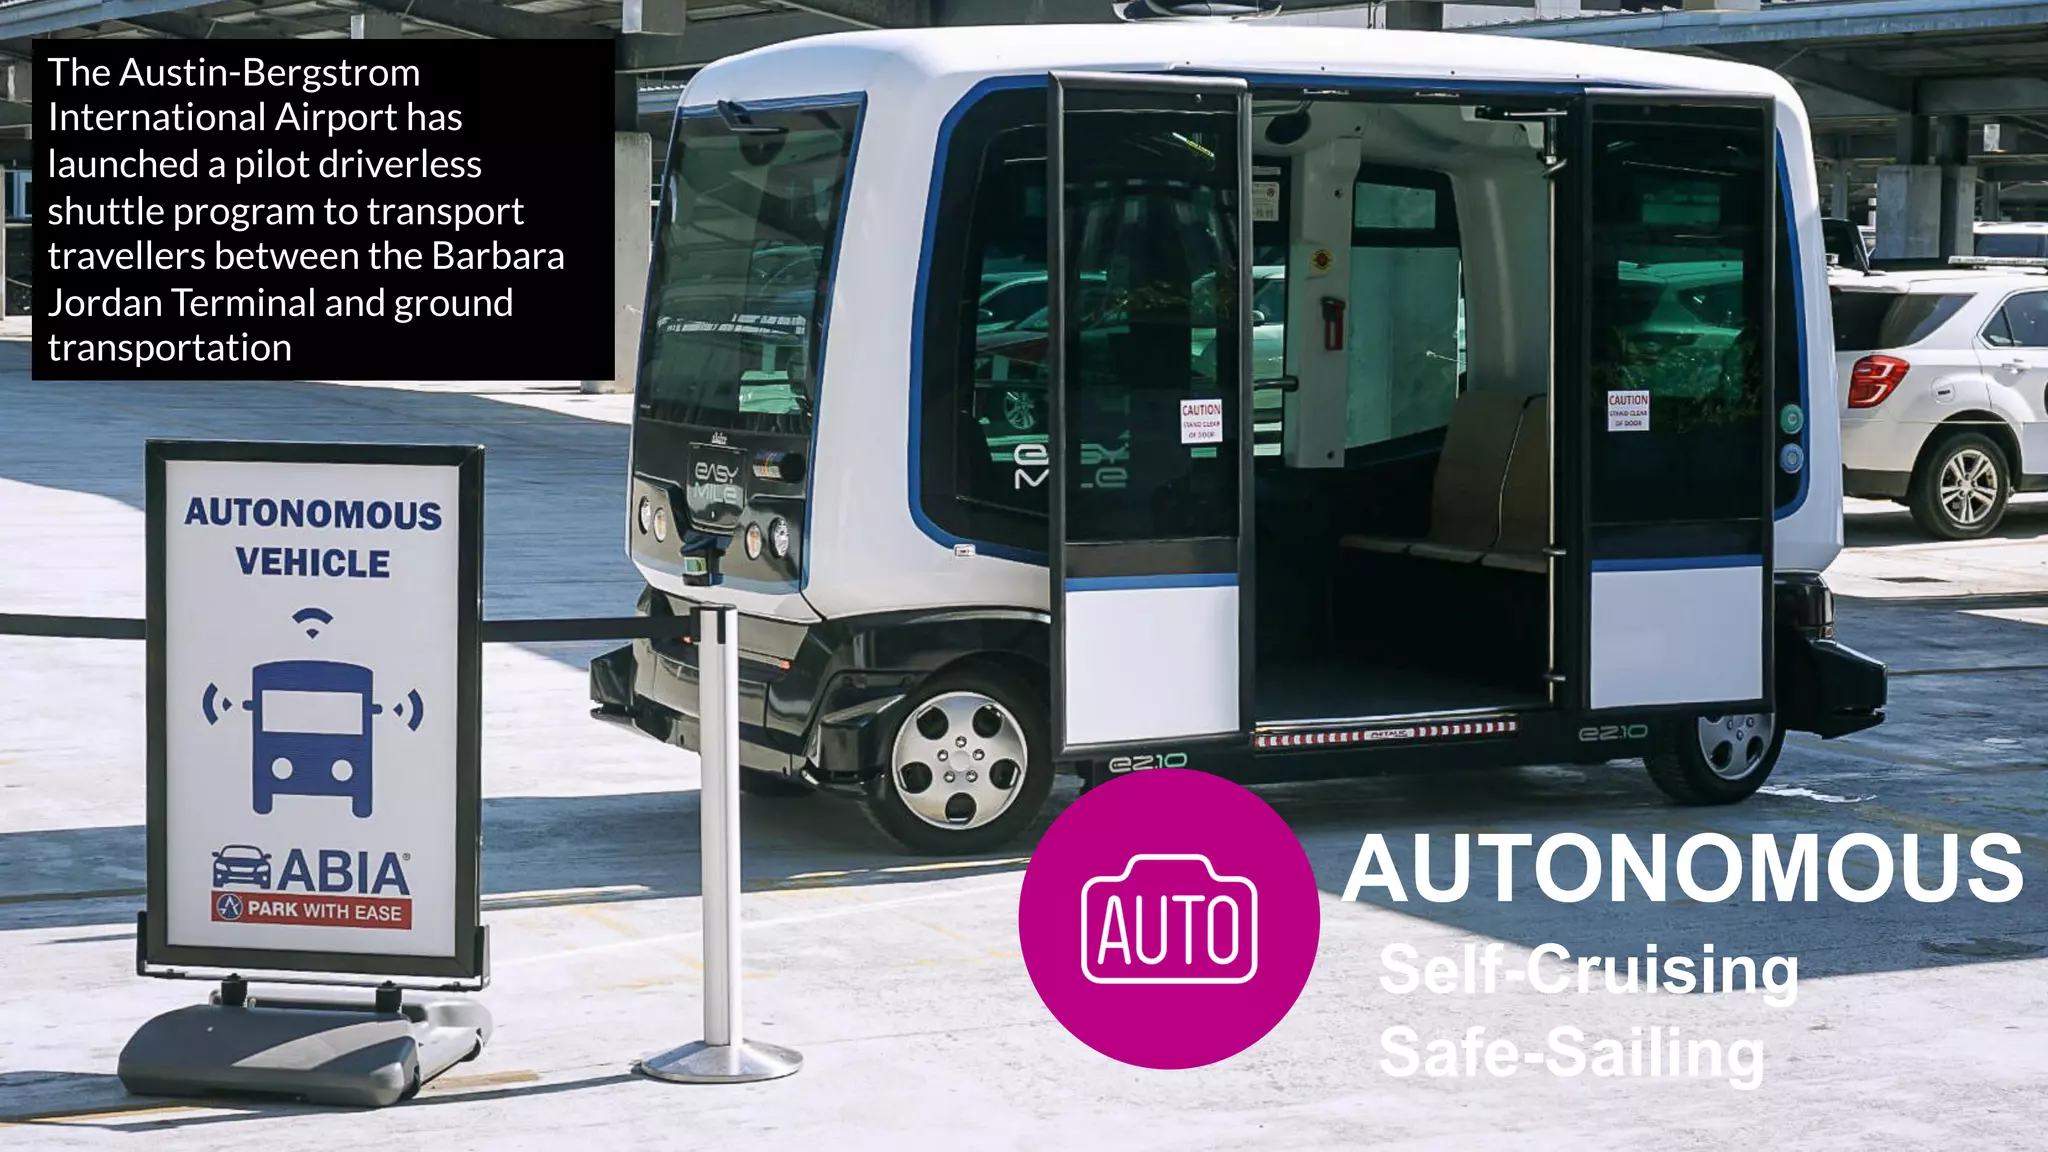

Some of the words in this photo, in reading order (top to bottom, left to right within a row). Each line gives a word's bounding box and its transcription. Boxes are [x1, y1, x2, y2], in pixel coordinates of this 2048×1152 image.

[1182, 404, 1221, 417] CAUTION
[1609, 394, 1648, 406] CAUTION
[184, 497, 442, 531] AUTONOMOUS
[236, 546, 390, 579] VEHICLE
[276, 848, 411, 896] ABIA
[248, 901, 299, 918] PARK
[303, 903, 349, 920] WITH
[355, 905, 402, 922] EASE
